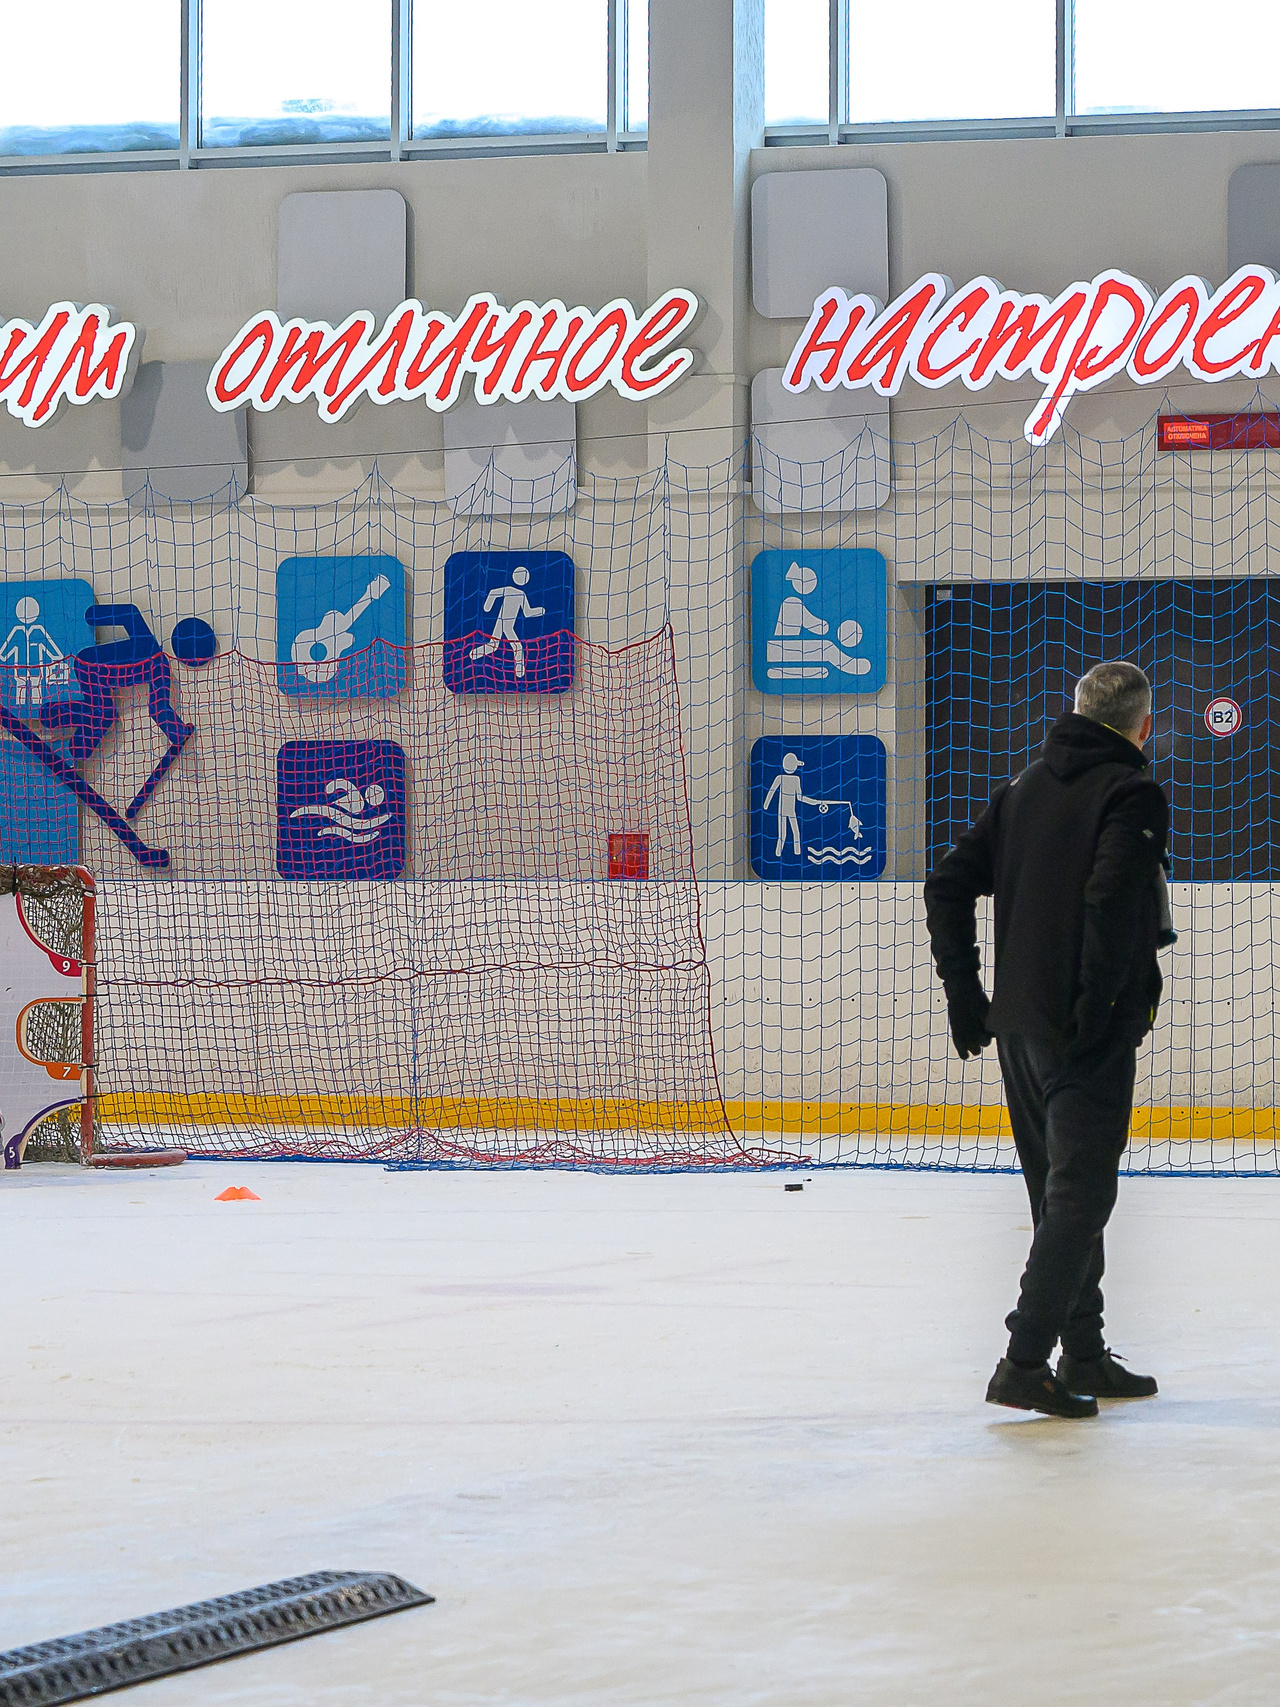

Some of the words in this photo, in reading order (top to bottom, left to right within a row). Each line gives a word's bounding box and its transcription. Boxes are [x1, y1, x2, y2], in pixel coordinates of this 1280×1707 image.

[215, 297, 698, 415] отличное
[62, 960, 71, 972] 9
[62, 1066, 72, 1078] 7
[9, 1146, 16, 1159] 5
